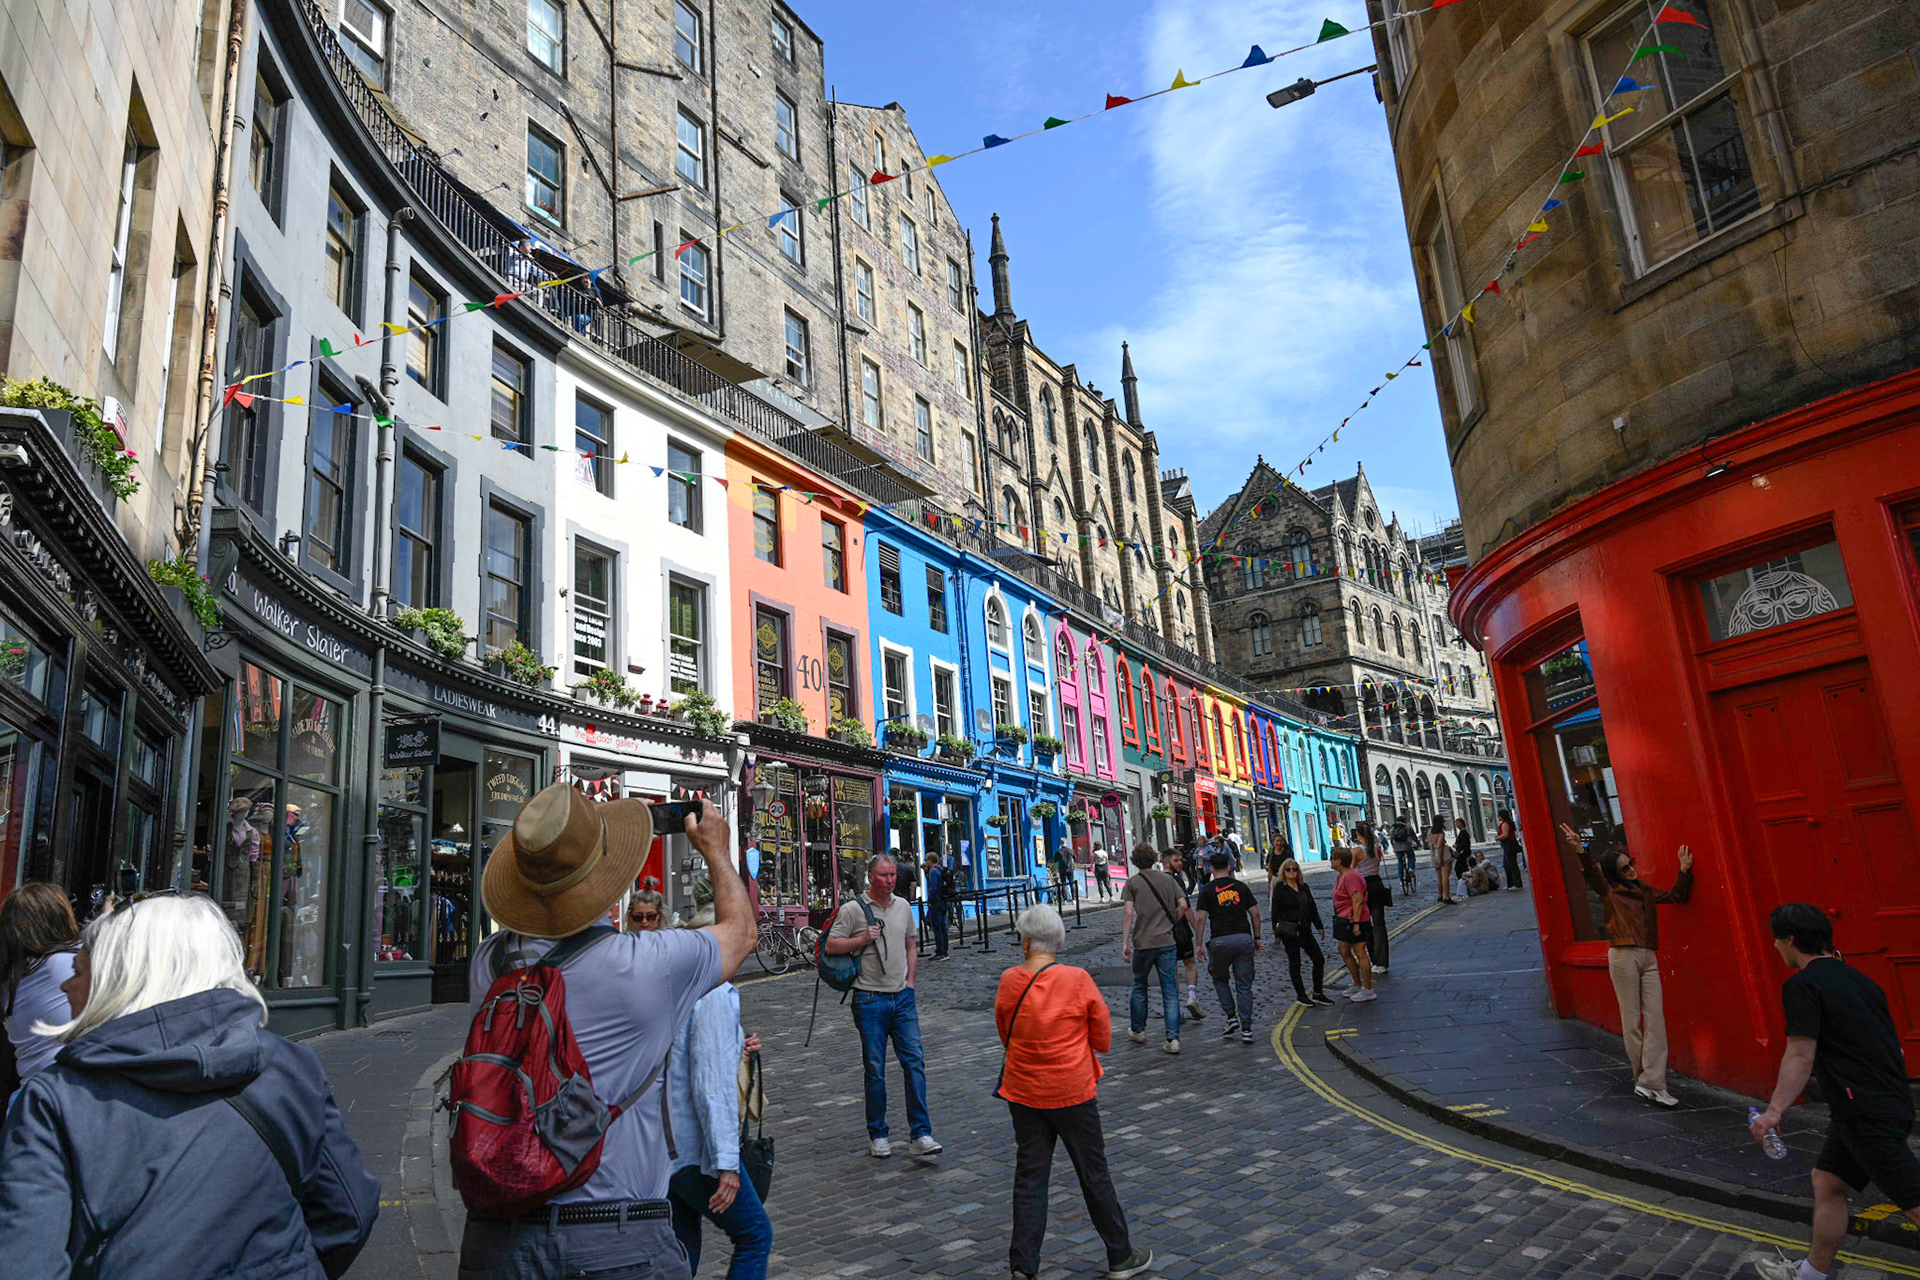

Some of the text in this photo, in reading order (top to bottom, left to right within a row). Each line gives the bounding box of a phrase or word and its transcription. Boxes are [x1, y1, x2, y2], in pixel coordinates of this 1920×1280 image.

[254, 589, 299, 636] Walker
[797, 655, 822, 692] 40
[434, 686, 496, 719] LADIESWEAR
[574, 729, 586, 740] the
[596, 731, 613, 745] door
[615, 738, 640, 750] gallery
[389, 751, 413, 760] Walker
[486, 773, 507, 791] TWEED
[770, 805, 785, 815] 20
[758, 811, 792, 831] MUSUM
[1217, 889, 1241, 906] HOOPS
